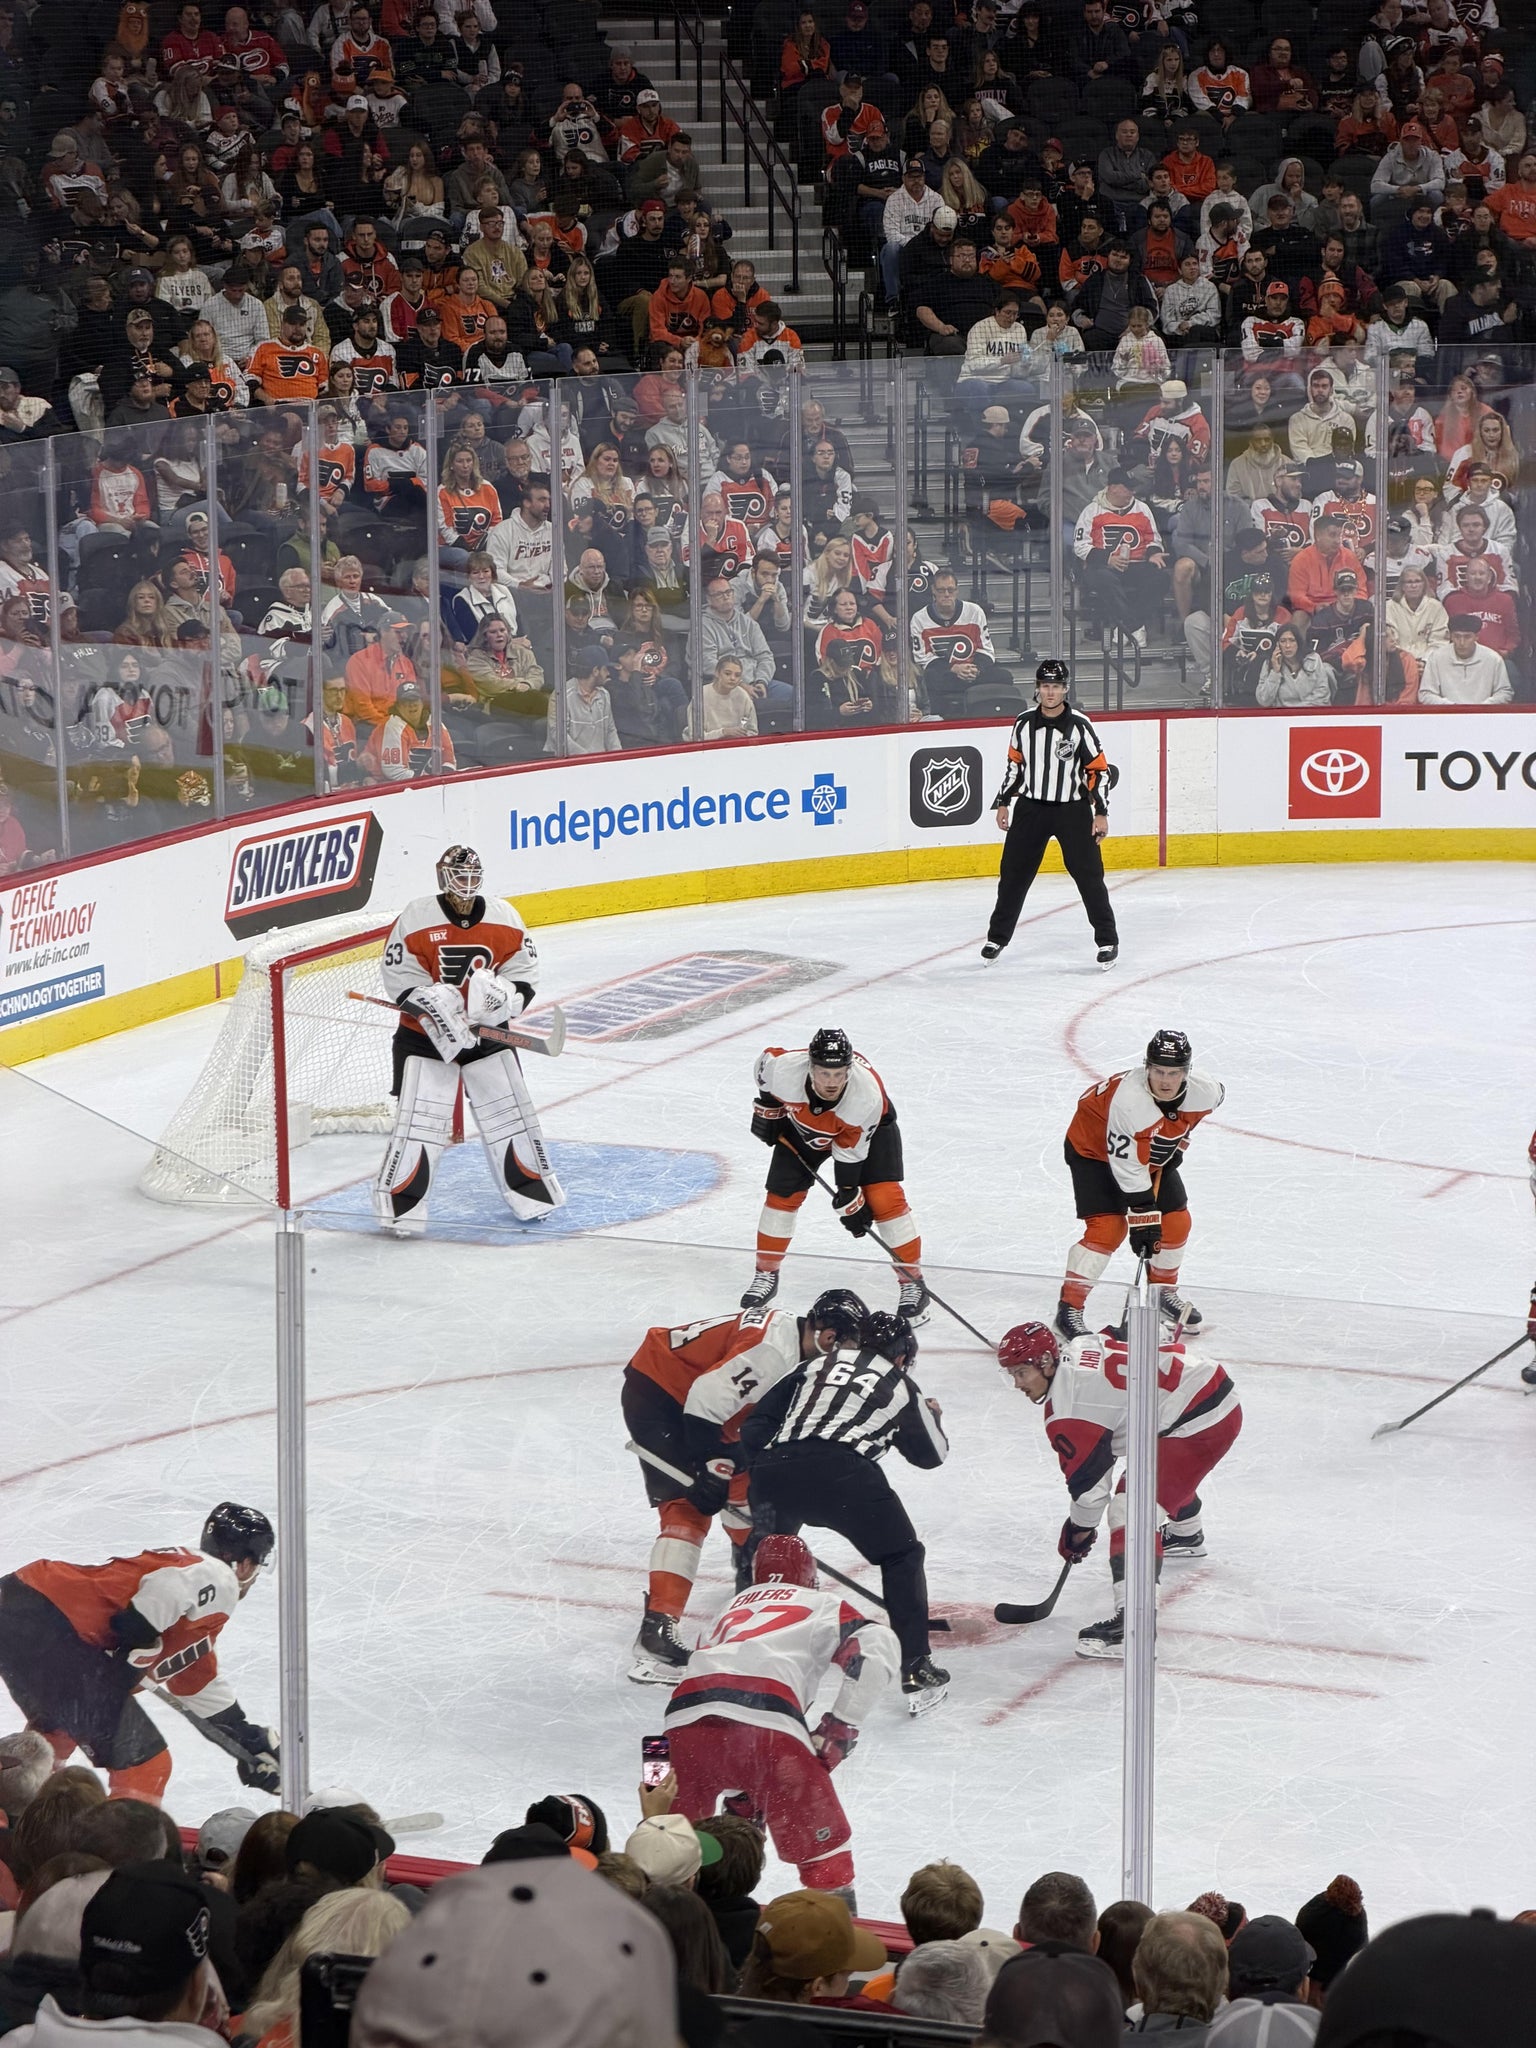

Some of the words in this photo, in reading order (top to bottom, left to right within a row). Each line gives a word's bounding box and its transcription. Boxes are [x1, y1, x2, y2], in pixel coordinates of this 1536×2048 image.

[868, 159, 900, 173] EAGLES
[170, 284, 203, 298] FLYERS
[464, 367, 482, 383] 77
[727, 535, 738, 551] C
[919, 565, 930, 577] C
[931, 773, 962, 804] NHL
[510, 782, 790, 850] Independence
[232, 824, 361, 907] SNICKERS
[11, 879, 58, 920] OFFICE
[9, 901, 97, 954] TECHNOLOGY
[429, 931, 448, 943] IBX
[5, 941, 90, 978] www.kdi-inc.com
[384, 942, 404, 967] 53
[0, 988, 54, 1020] CHNOLOGY
[54, 972, 102, 1000] TOGETHER
[533, 1138, 549, 1171] BAUER
[1107, 1129, 1131, 1160] 52
[385, 1149, 401, 1187] BAUER
[1079, 1350, 1101, 1370] AHO
[731, 1366, 759, 1399] 14
[825, 1361, 881, 1400] 64
[206, 1521, 215, 1535] 6
[768, 1573, 784, 1584] 27
[729, 1588, 797, 1611] EHLERS
